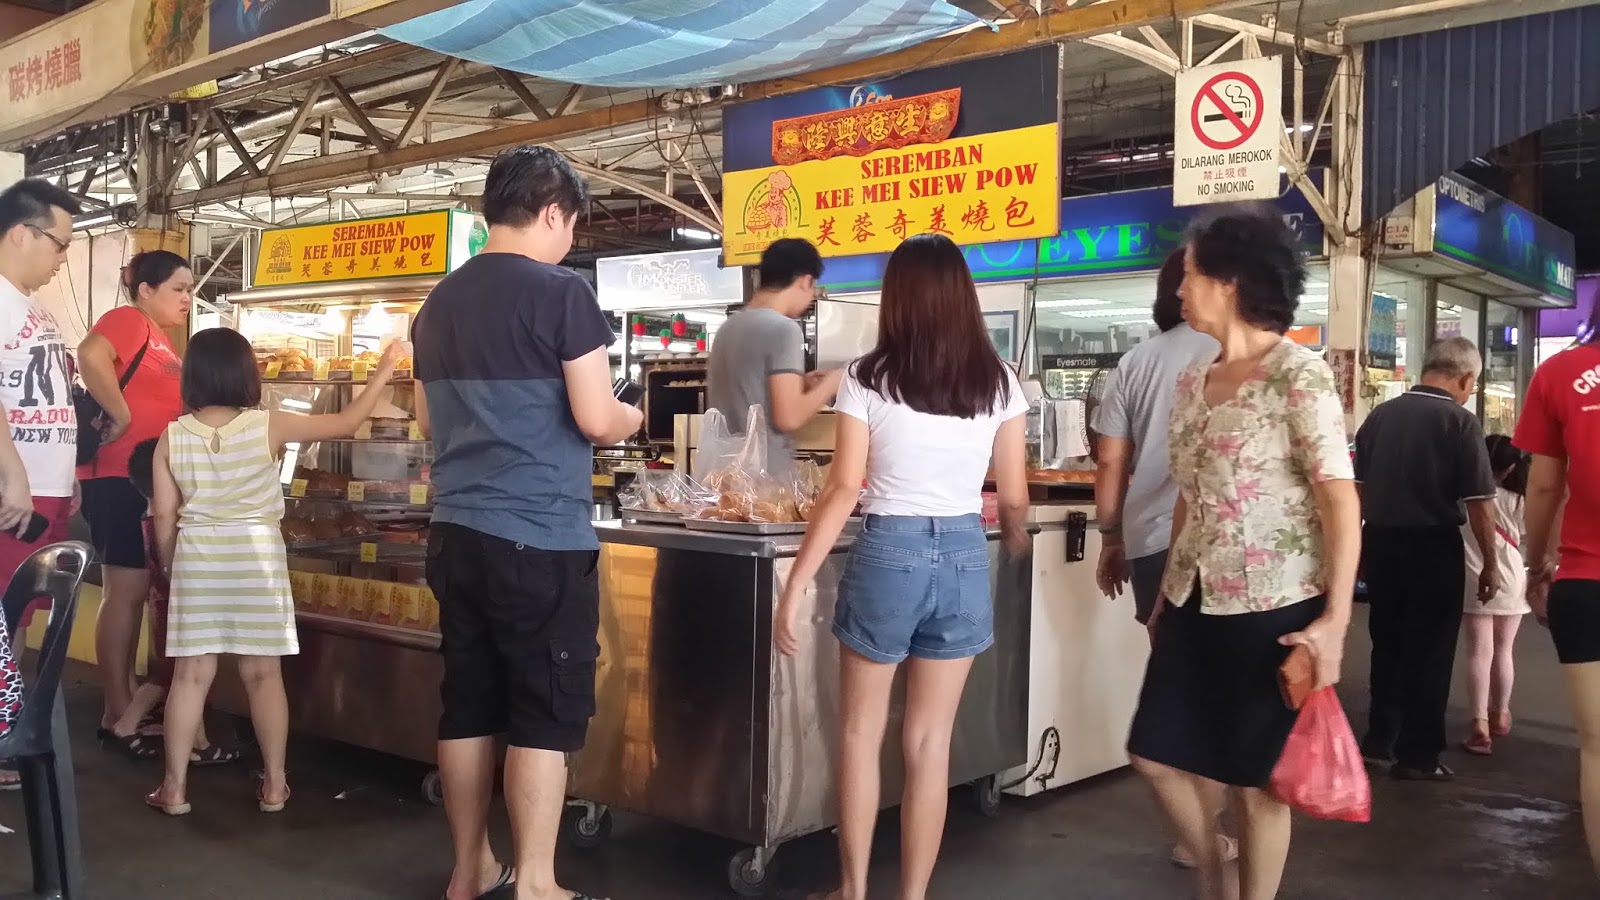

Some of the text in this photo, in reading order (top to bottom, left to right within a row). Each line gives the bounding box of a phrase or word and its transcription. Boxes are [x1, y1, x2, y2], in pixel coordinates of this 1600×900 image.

[861, 144, 983, 180] SEREMBAN
[1181, 149, 1272, 169] DILARANG MEROKOK
[815, 163, 1038, 211] KEE MEI SIEW POW
[1197, 180, 1255, 196] NO SMOKING
[332, 220, 405, 242] SEREMBAN
[816, 196, 1035, 247] 芙蓉奇美燒包
[303, 233, 436, 261] KEE MEI SIEW POW
[1056, 357, 1097, 368] Eyesmate
[13, 427, 53, 444] NEW
